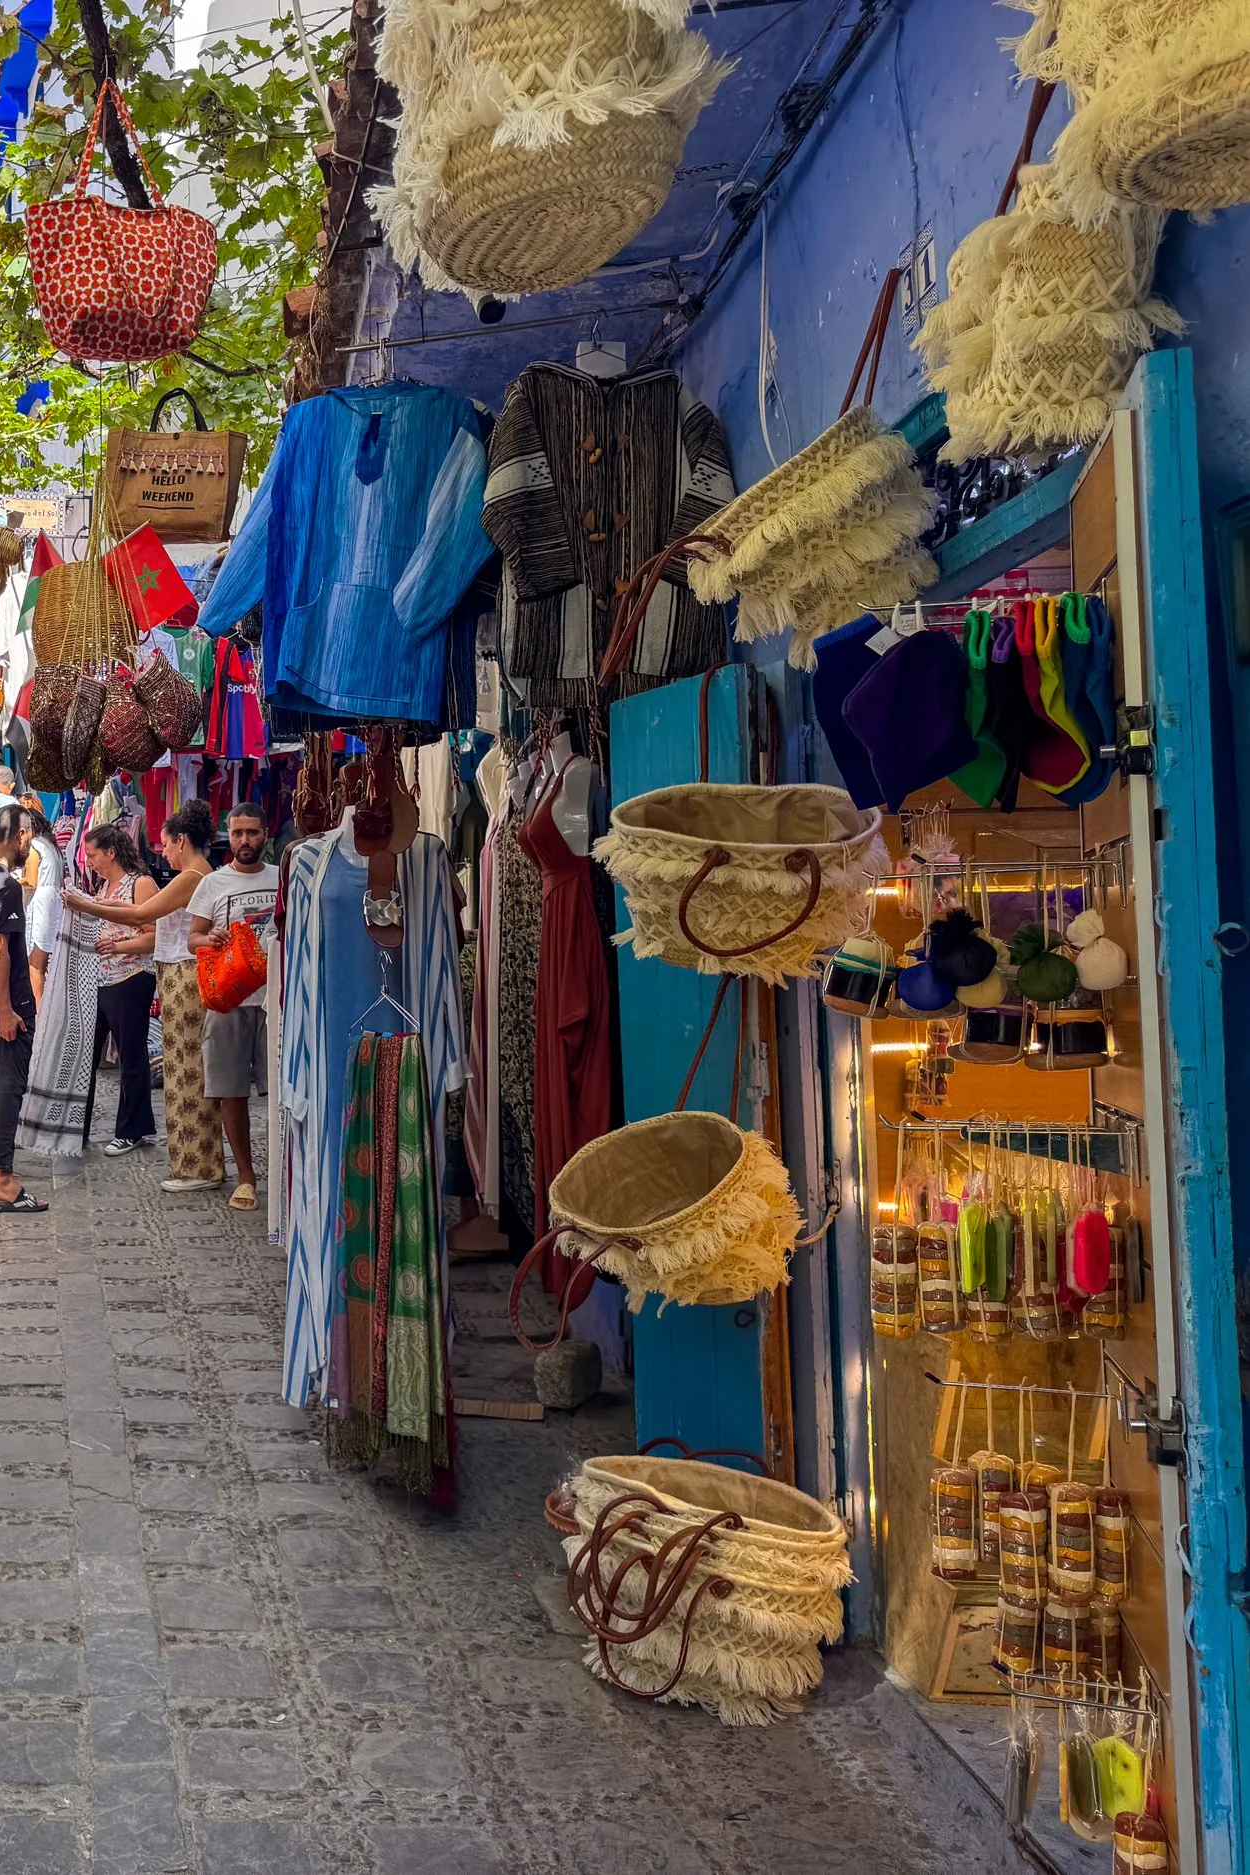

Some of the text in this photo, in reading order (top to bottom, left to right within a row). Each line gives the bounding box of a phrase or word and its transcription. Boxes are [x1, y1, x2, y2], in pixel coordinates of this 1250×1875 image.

[152, 475, 186, 486] HELLO
[142, 490, 194, 502] WEEKEND
[32, 509, 45, 517] del
[227, 683, 257, 694] Spotify
[231, 894, 277, 907] FLORID
